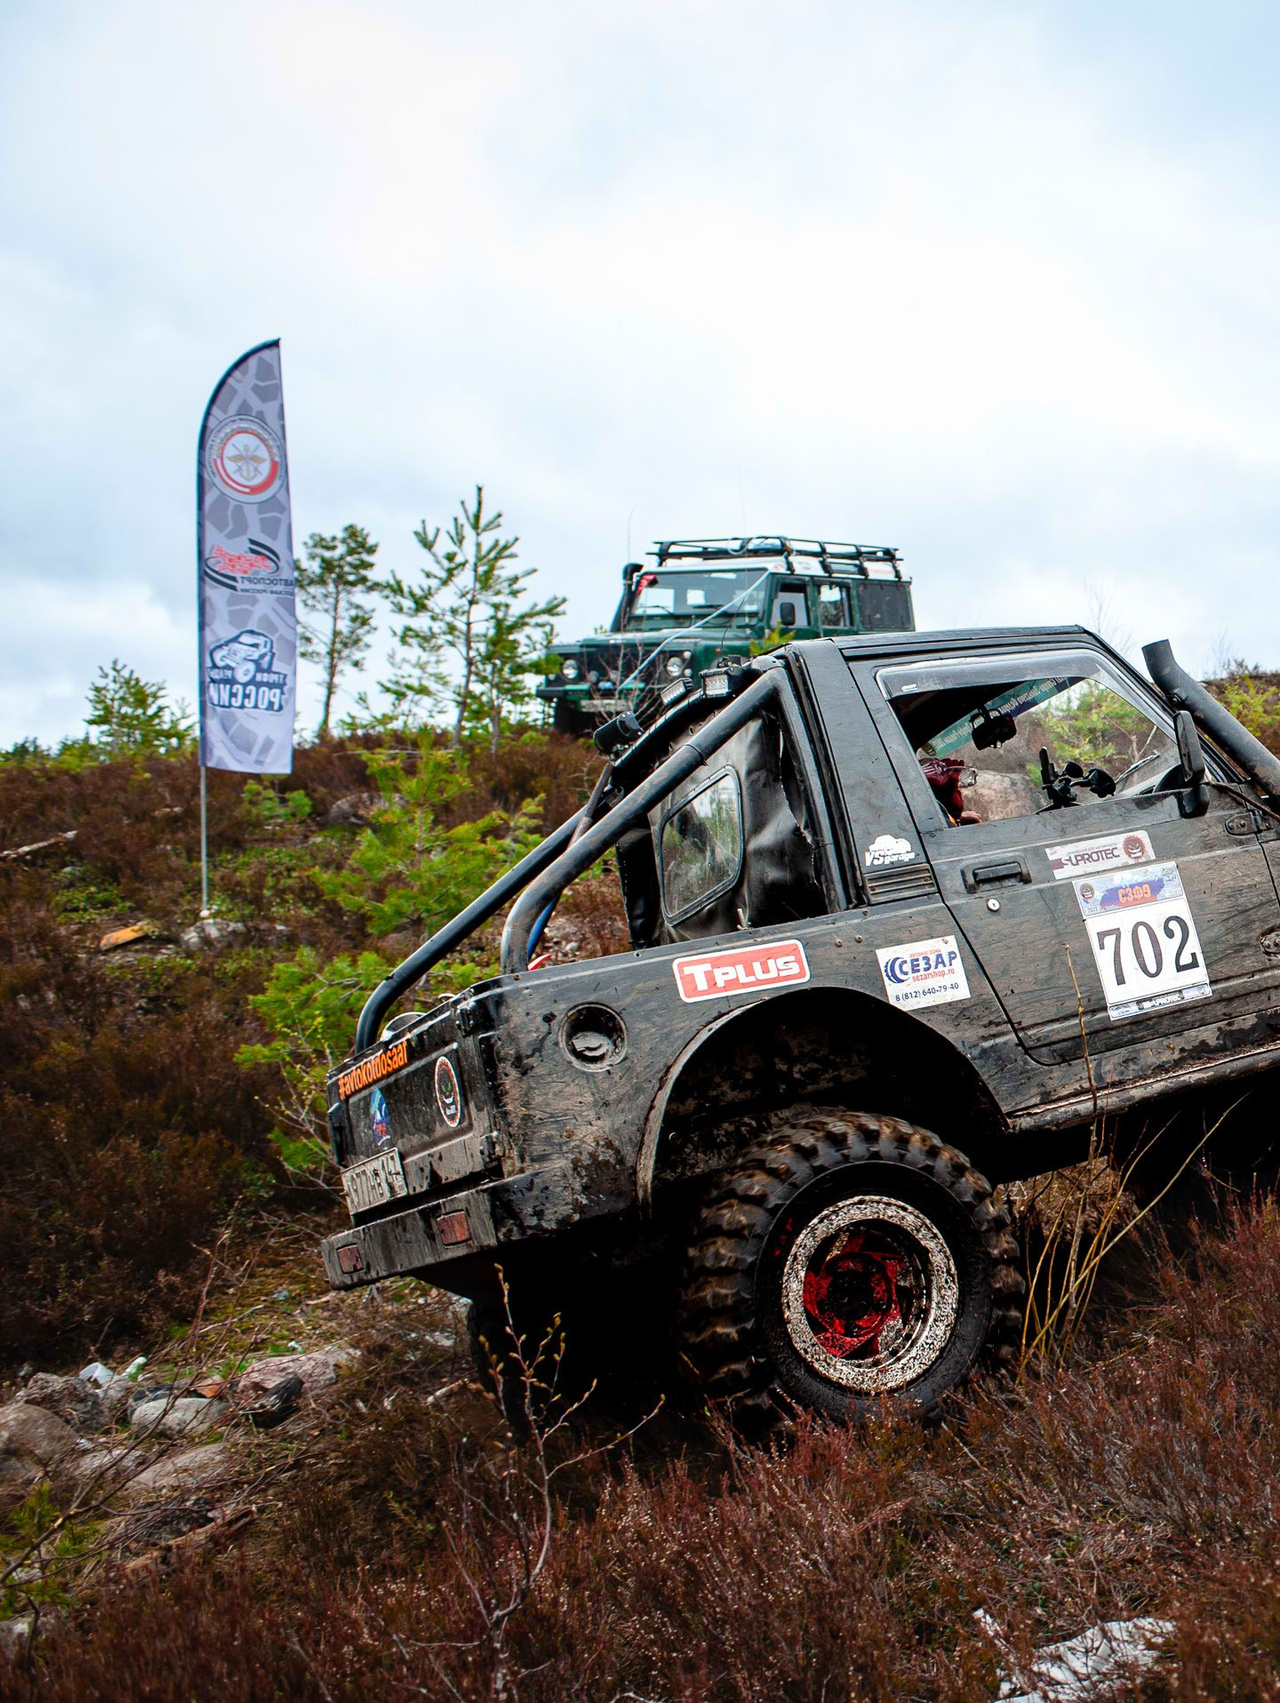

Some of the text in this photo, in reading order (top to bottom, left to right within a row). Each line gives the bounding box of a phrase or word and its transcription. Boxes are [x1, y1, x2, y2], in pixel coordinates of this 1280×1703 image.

[864, 851, 916, 867] VS garage
[1117, 884, 1151, 903] СЗФО
[1096, 915, 1199, 986] 702
[899, 951, 957, 976] СЕЗАР
[912, 968, 955, 982] sezarshop.ru
[902, 990, 921, 1002] (812)
[922, 982, 959, 997] 640-79-40
